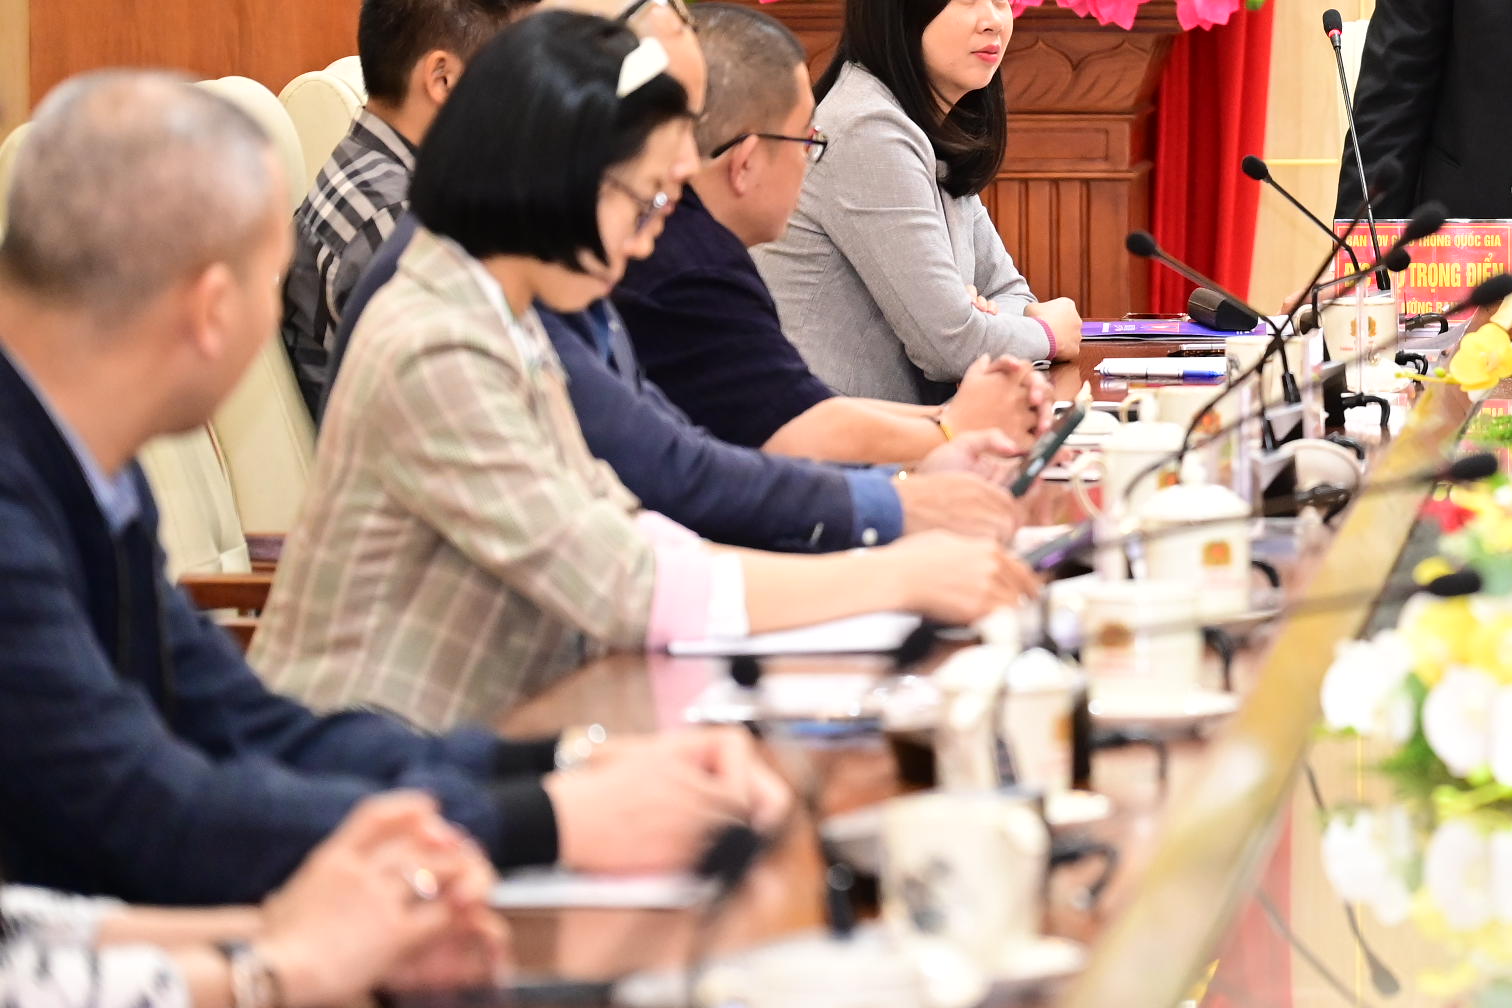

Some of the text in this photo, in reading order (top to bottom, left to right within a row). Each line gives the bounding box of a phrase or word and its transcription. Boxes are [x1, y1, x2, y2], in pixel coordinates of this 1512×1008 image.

[1371, 235, 1389, 247] OV
[1454, 232, 1482, 249] QUỐC
[1484, 234, 1502, 247] GIA
[1410, 263, 1462, 293] TRỌNG
[1466, 252, 1505, 288] ĐIỂN
